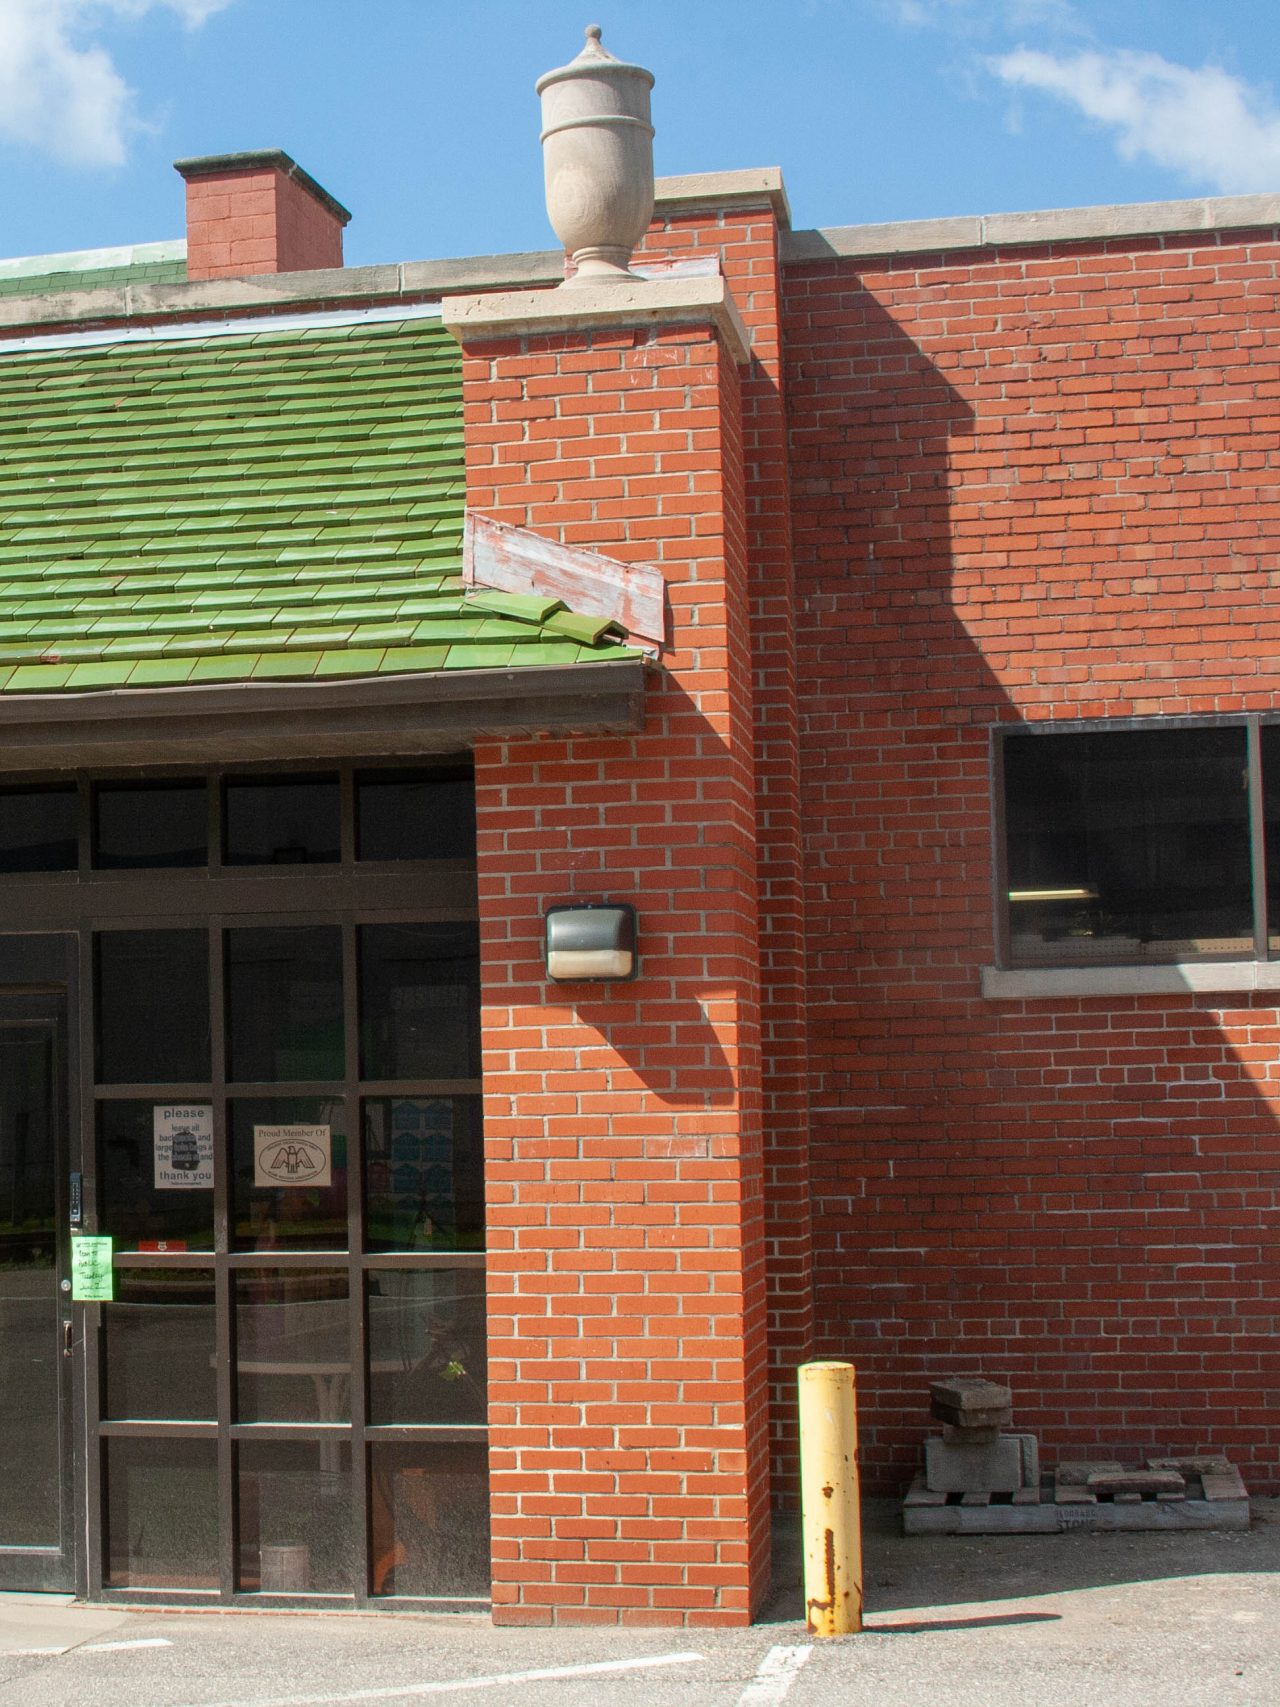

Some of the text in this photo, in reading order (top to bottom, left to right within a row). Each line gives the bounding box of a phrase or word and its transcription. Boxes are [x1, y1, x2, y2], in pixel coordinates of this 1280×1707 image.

[164, 1108, 205, 1120] please
[191, 1124, 200, 1132] all
[258, 1128, 327, 1137] Proud Member Of
[158, 1153, 170, 1161] the
[159, 1171, 212, 1181] thank you
[1055, 1519, 1097, 1530] STONE
